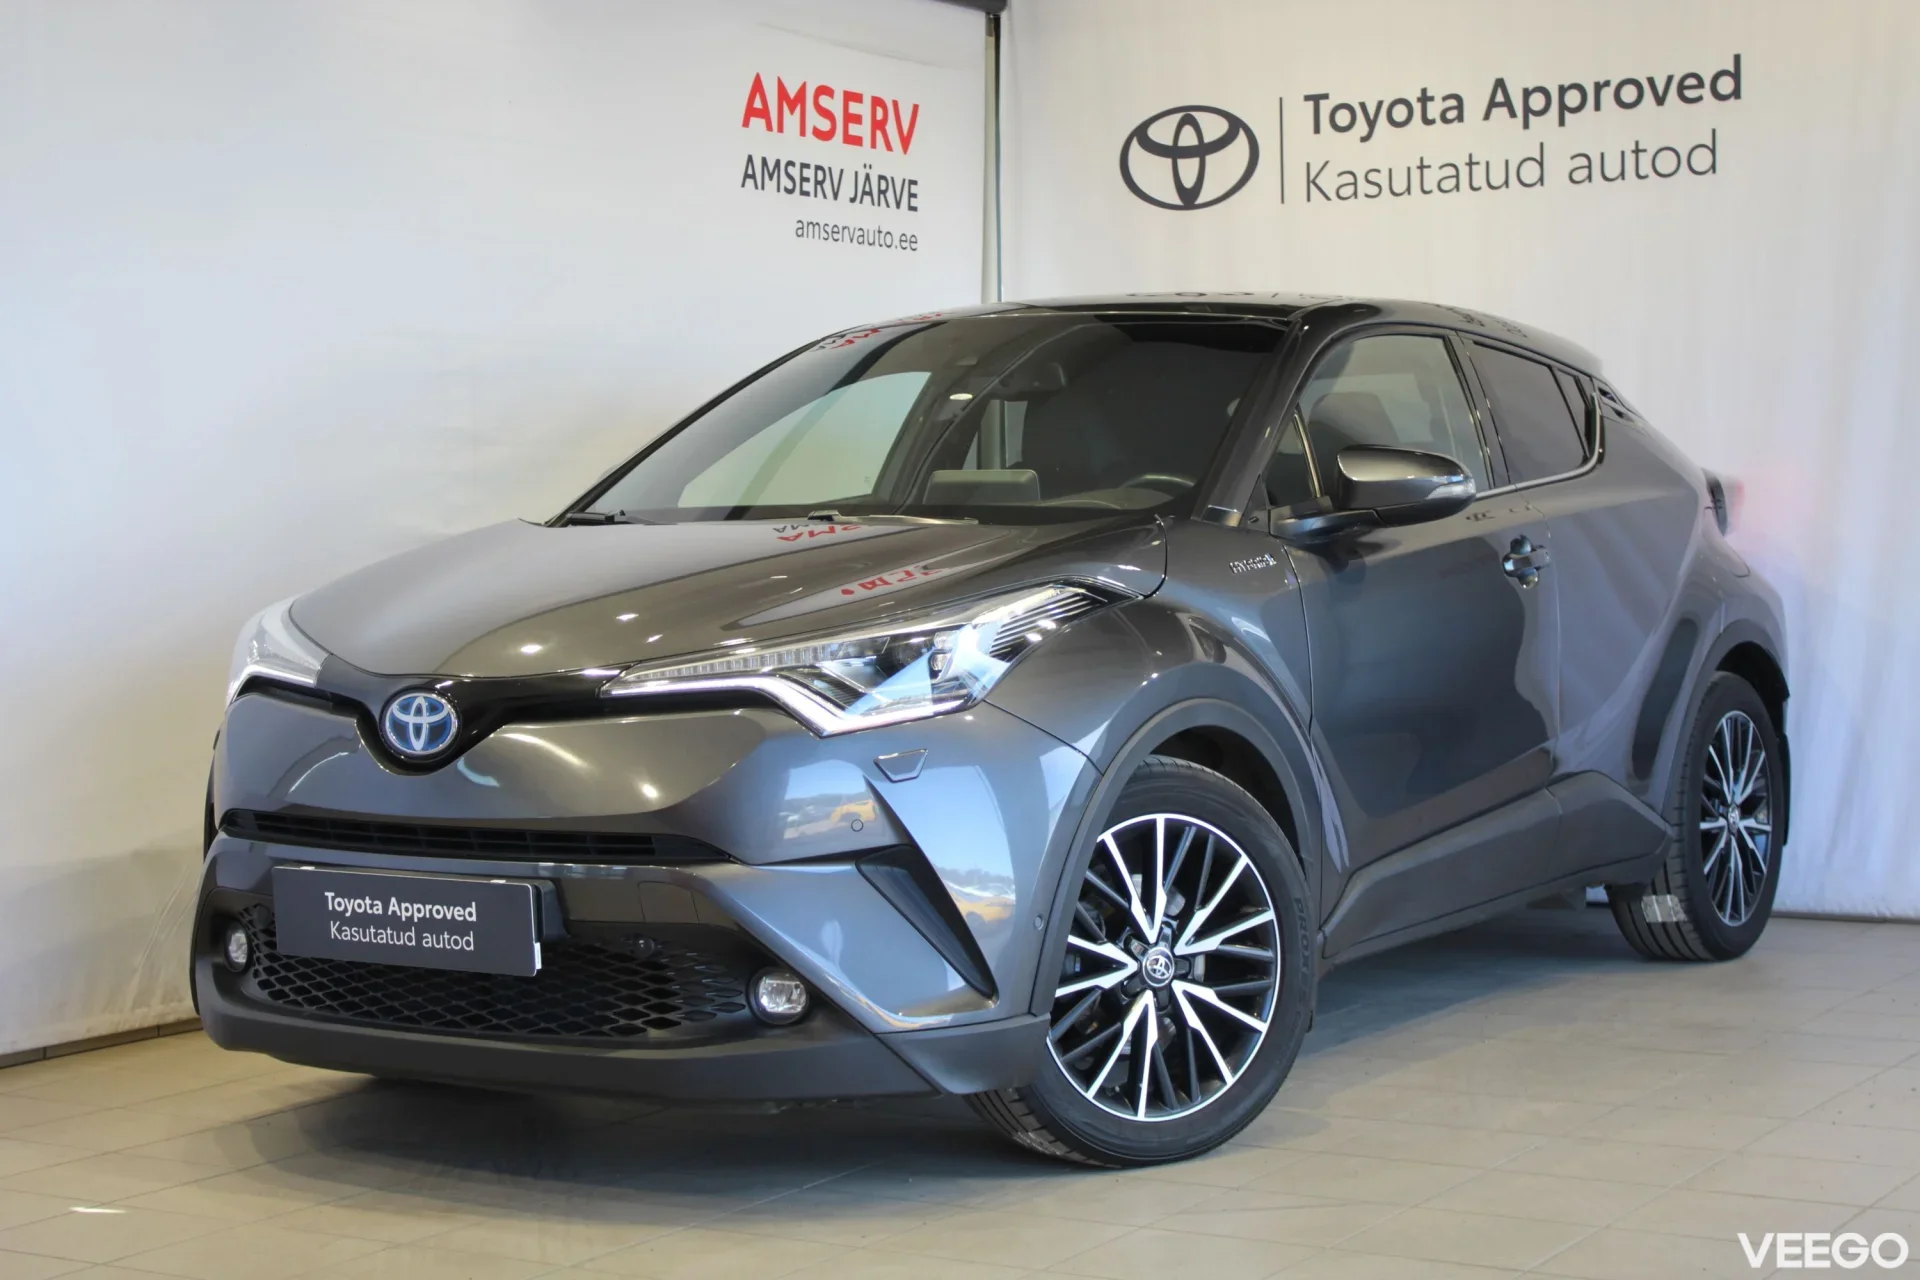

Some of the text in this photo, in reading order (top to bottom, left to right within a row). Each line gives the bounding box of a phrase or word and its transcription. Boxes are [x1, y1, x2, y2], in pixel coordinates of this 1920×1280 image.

[742, 72, 920, 155] AMSERV
[1303, 53, 1742, 142] Toyota Approved
[740, 153, 919, 212] AMSERV JÄRVE
[1306, 128, 1717, 203] Kasutatud autod
[795, 219, 918, 252] amservauto.ee
[324, 891, 477, 922] Toyota Approved
[330, 920, 474, 951] Kasutatud autod
